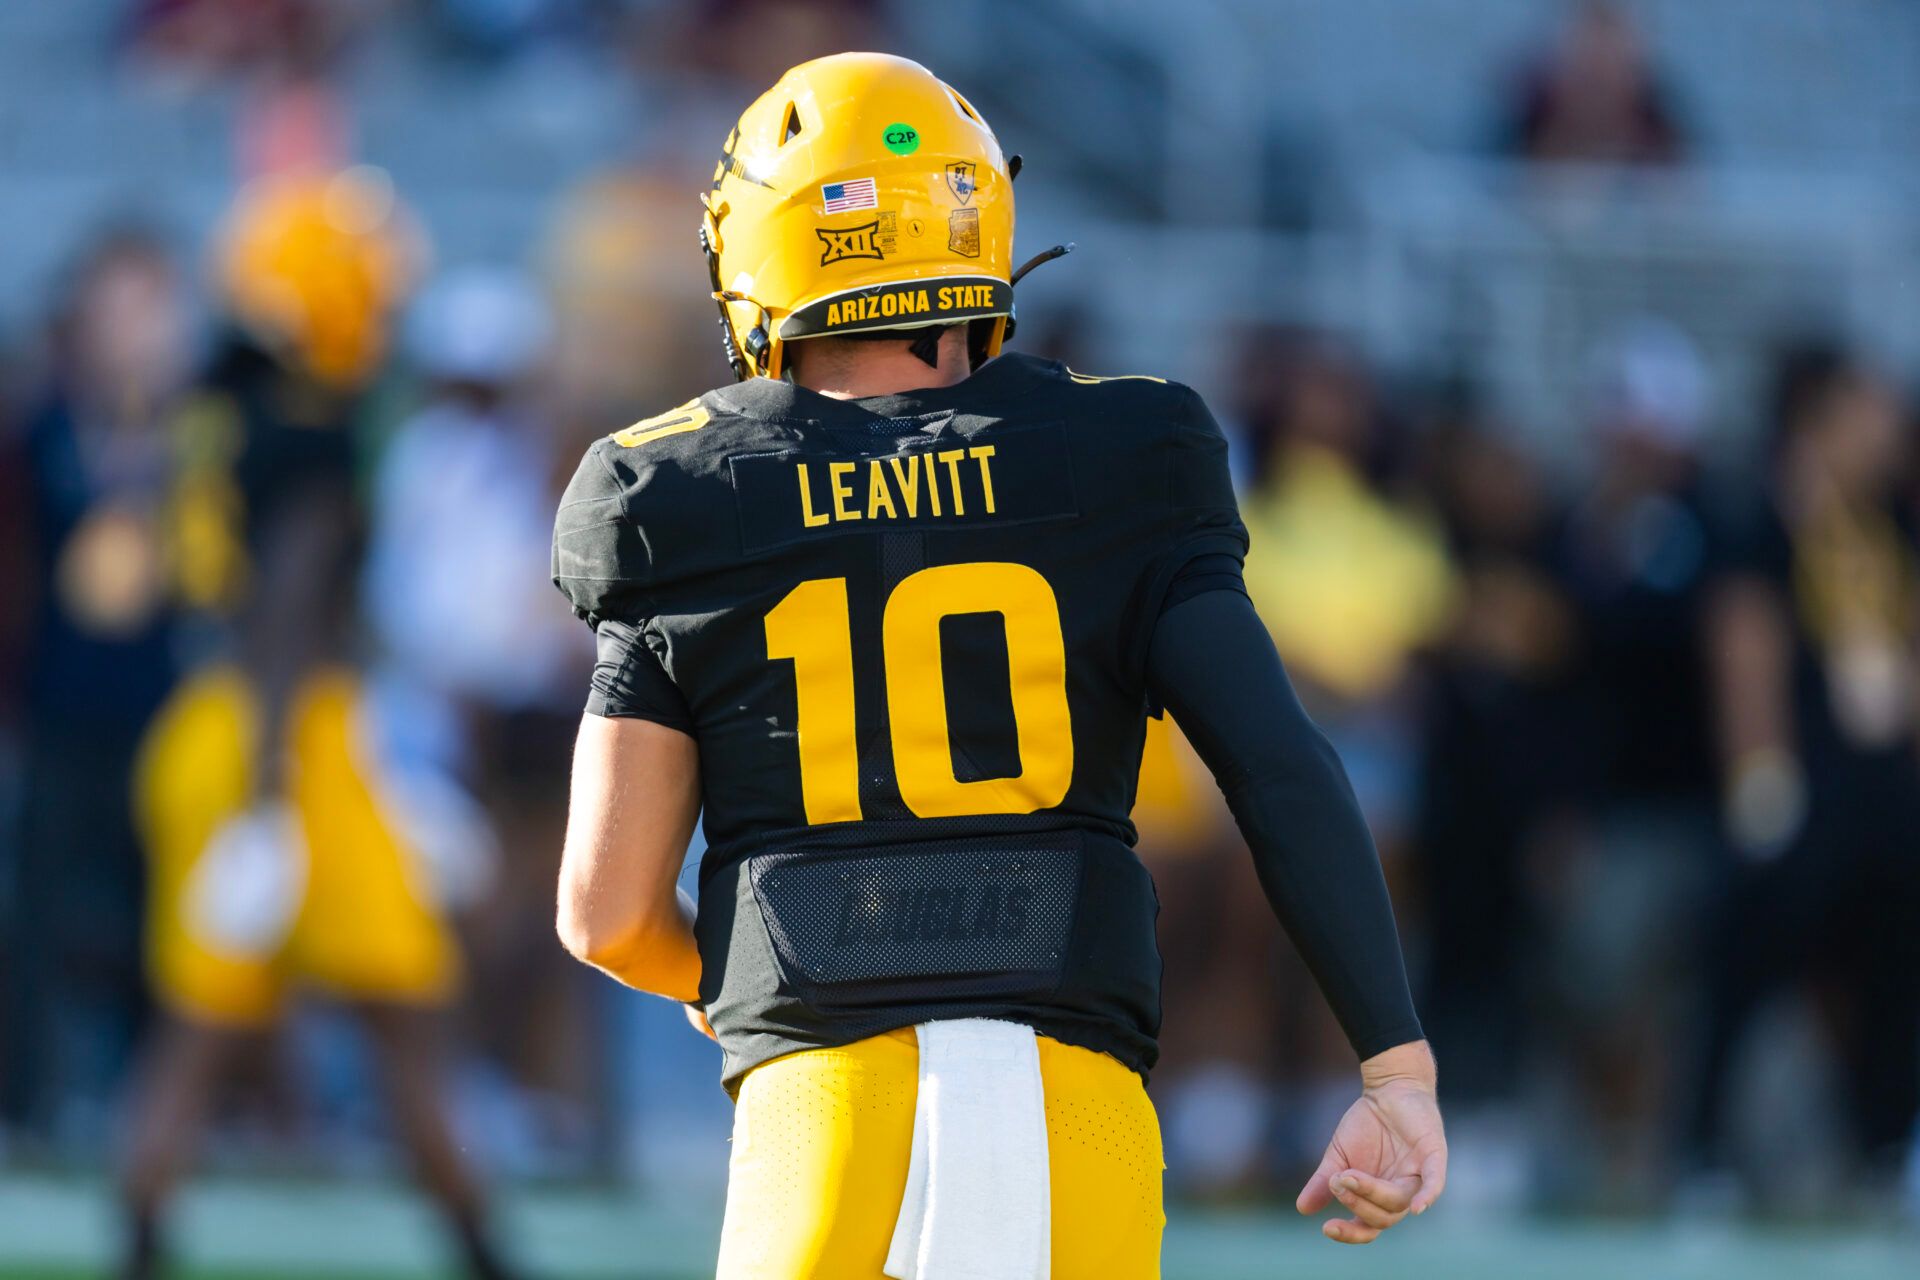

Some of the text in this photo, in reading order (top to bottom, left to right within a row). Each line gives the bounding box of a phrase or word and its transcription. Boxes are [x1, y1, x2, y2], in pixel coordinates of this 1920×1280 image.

[886, 131, 916, 145] C2P
[827, 285, 994, 327] ARIZONA STATE
[797, 445, 997, 528] LEAVITT
[764, 561, 1074, 826] 10
